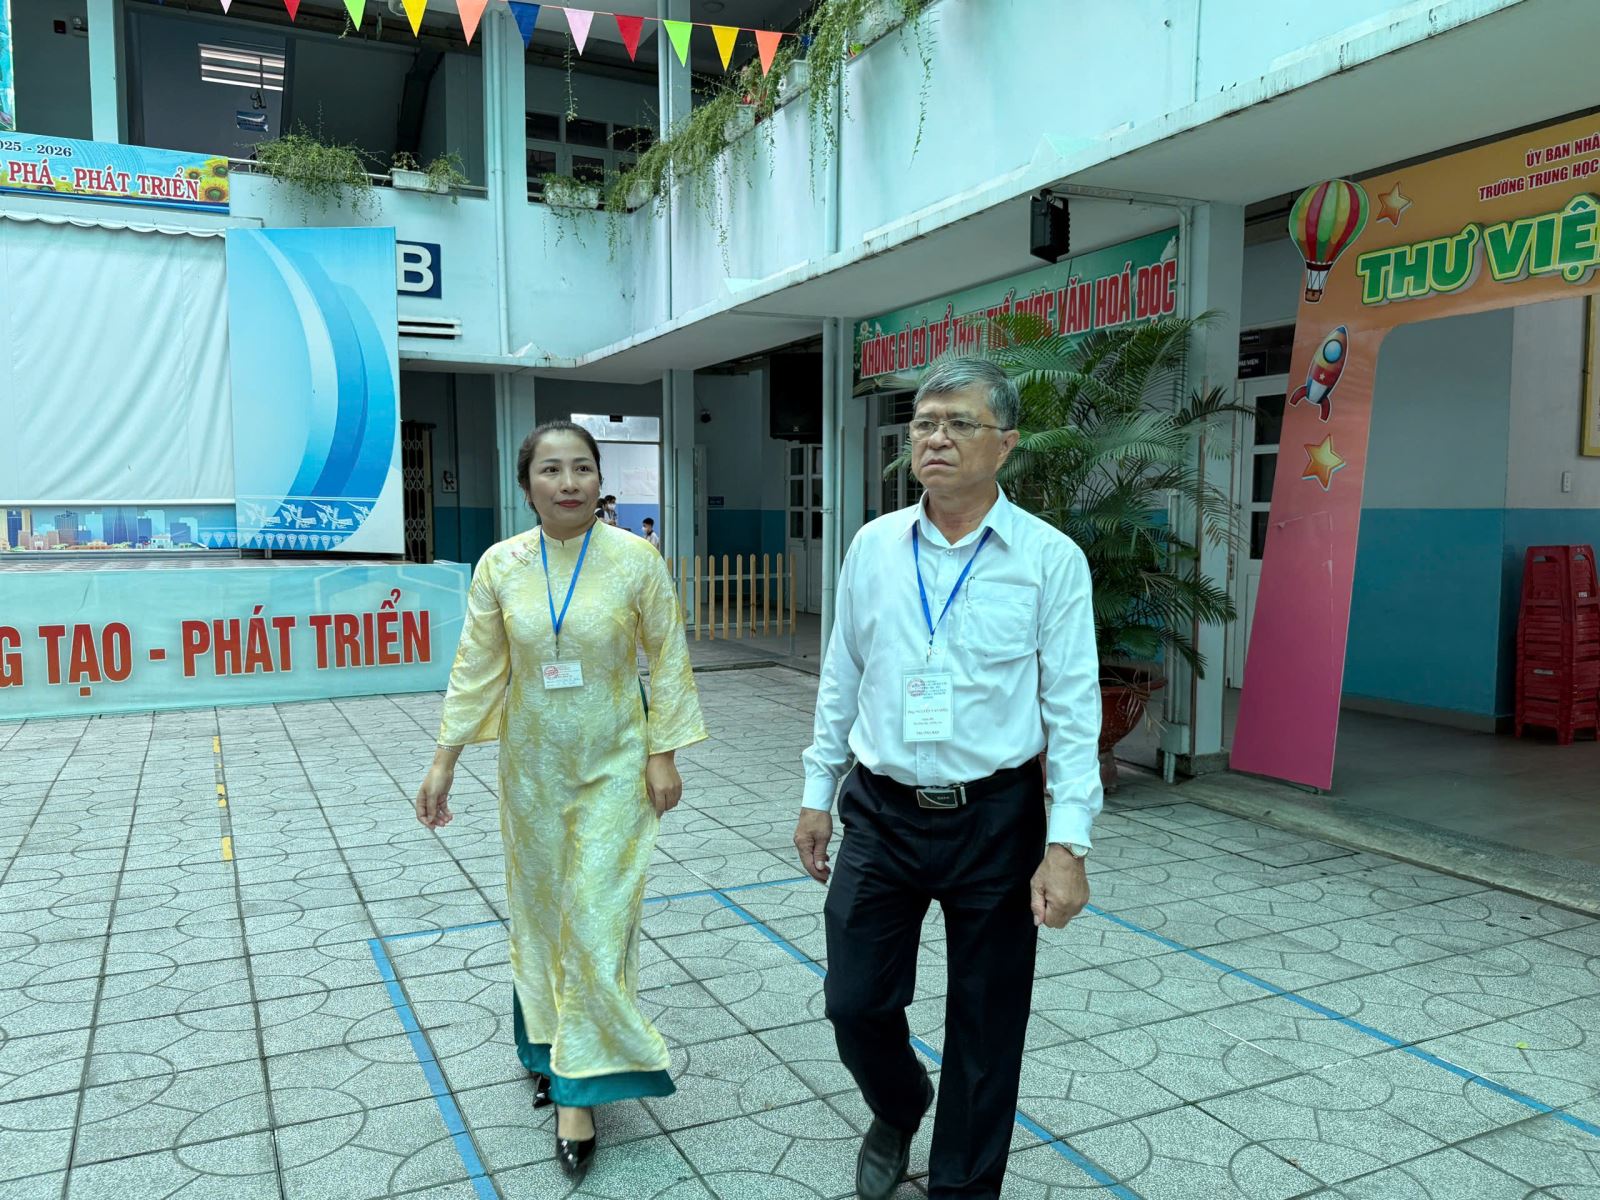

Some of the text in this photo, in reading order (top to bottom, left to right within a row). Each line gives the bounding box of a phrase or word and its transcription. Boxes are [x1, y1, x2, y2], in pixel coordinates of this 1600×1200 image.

[37, 144, 72, 157] 2026
[1545, 142, 1571, 162] BAN
[8, 158, 54, 185] PHÁ
[74, 166, 130, 193] PHÁT
[137, 167, 200, 200] TRIỂN
[1478, 158, 1599, 201] TRƯỜNG TRUNG HỌC
[396, 243, 434, 293] B
[1358, 195, 1600, 303] THƯ VIỆ
[861, 329, 895, 379] KHÔNG
[897, 323, 909, 370] GÌ
[911, 318, 926, 368] CÓ
[928, 303, 952, 362] THỂ
[1056, 277, 1092, 338] VĂN
[1095, 261, 1132, 329] HOÁ
[1136, 259, 1177, 325] ĐỌC
[38, 621, 133, 698] TẠO
[149, 648, 166, 661] -
[181, 604, 297, 678] PHÁT
[309, 588, 432, 670] TRIỂN
